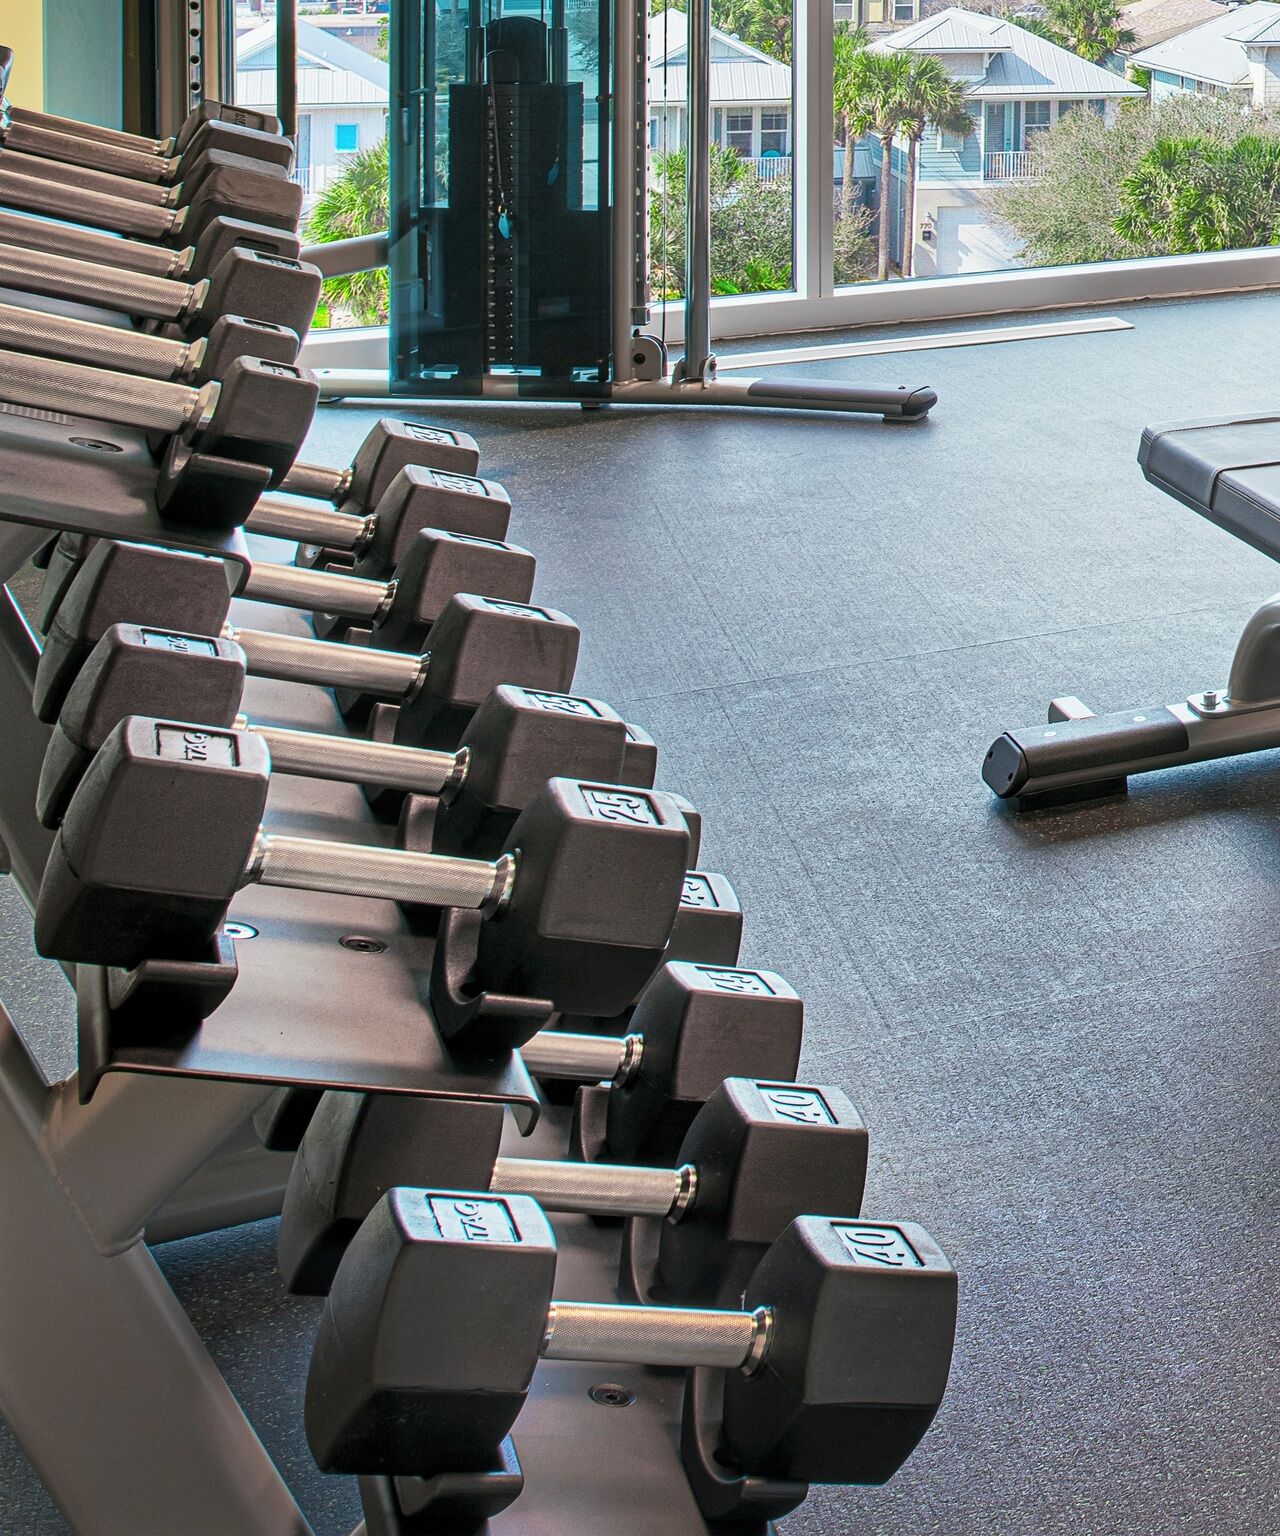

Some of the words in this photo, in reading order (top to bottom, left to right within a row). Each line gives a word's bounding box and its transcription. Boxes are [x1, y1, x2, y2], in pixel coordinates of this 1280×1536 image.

[534, 693, 590, 716] 25
[183, 731, 208, 761] TAG
[590, 792, 650, 824] 25
[704, 971, 761, 994] 45
[767, 1093, 822, 1124] 40
[453, 1202, 489, 1241] TAG
[844, 1230, 906, 1266] 40
